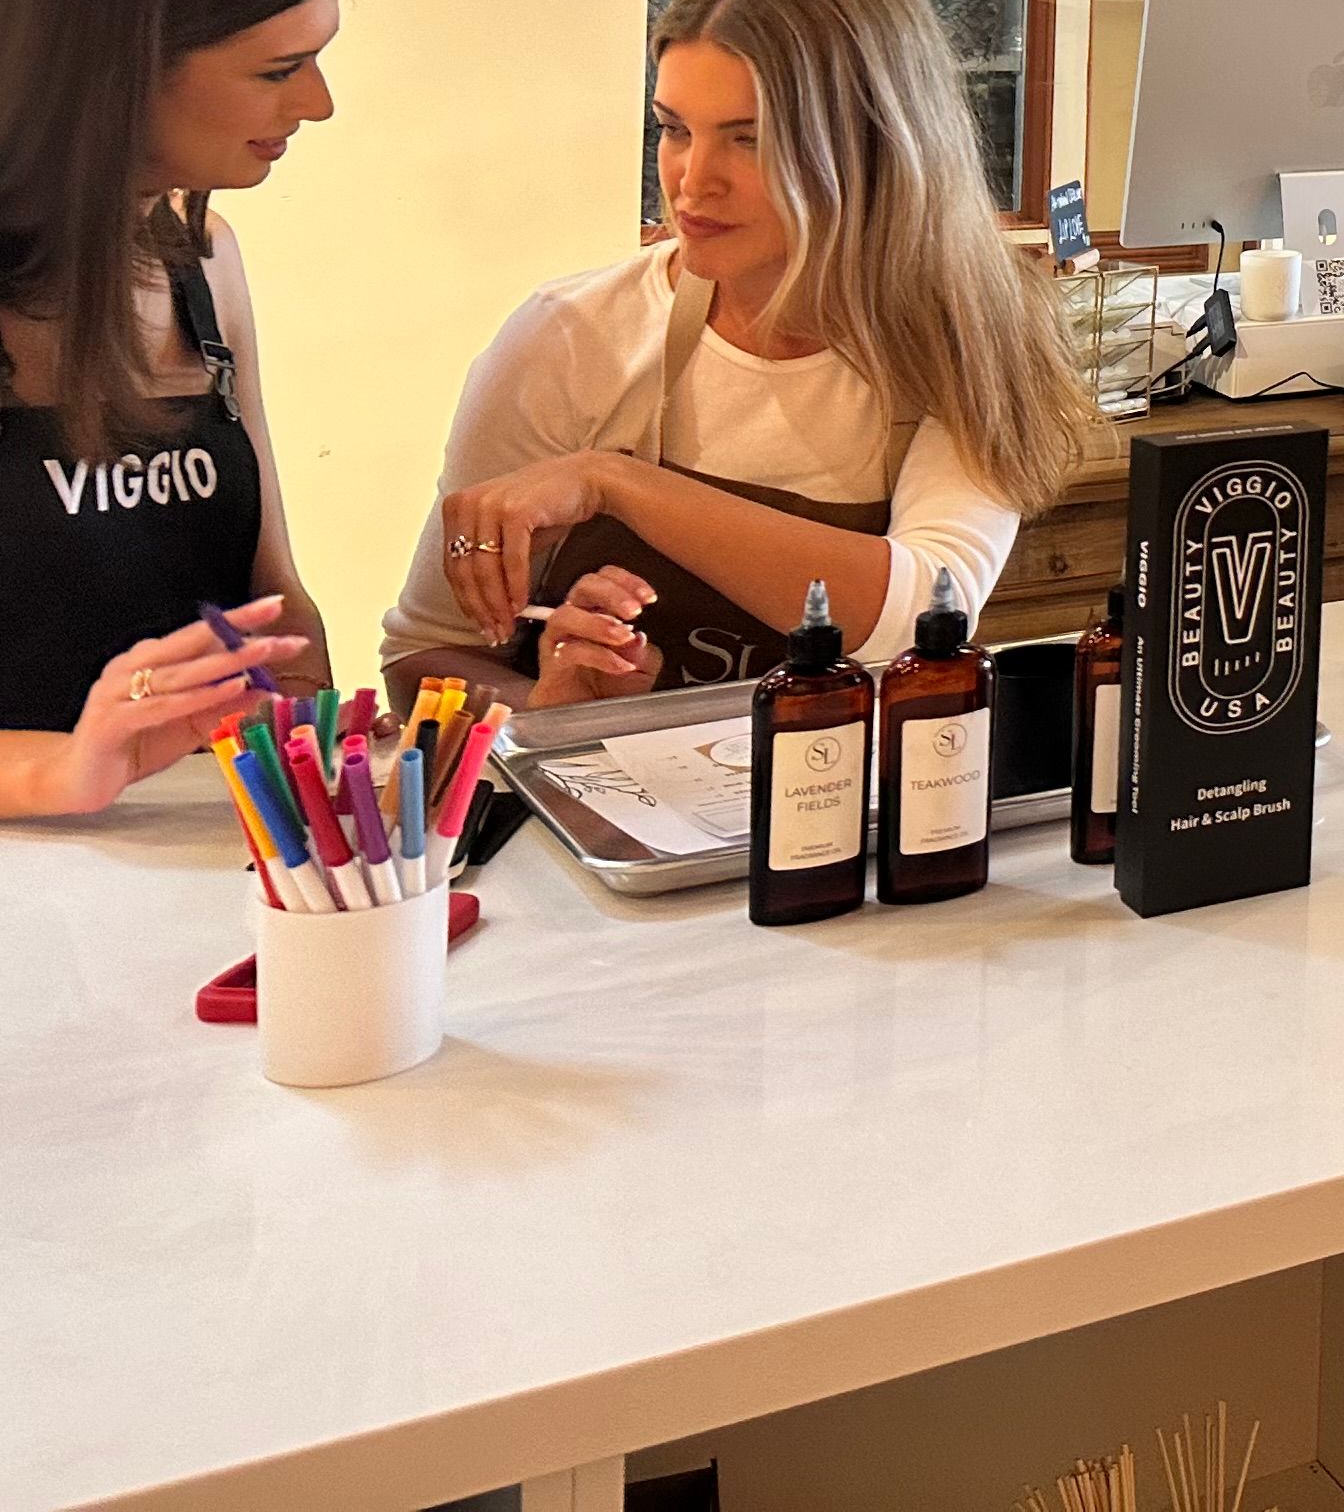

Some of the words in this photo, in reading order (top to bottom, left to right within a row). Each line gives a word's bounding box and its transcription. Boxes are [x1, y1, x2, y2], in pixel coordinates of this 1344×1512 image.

[43, 447, 218, 515] VIGGIO
[1195, 475, 1292, 514] VIGGIO
[1138, 540, 1149, 608] VIGGIO
[1276, 527, 1297, 653] BEAUTY
[1182, 539, 1204, 667] BEAUTY
[1137, 635, 1145, 655] An
[1134, 657, 1144, 716] Ultimate
[1200, 692, 1271, 718] USA
[1132, 717, 1142, 784] Grooming
[785, 778, 852, 798] LAVENDER
[911, 770, 981, 791] TEAKWOOD
[1197, 779, 1267, 801] Detangling
[796, 796, 841, 812] FIELDS
[1131, 786, 1139, 814] Tool
[1170, 815, 1200, 831] Hair
[1201, 813, 1213, 825] &
[1215, 807, 1251, 821] Scalp
[1253, 798, 1291, 816] Brush
